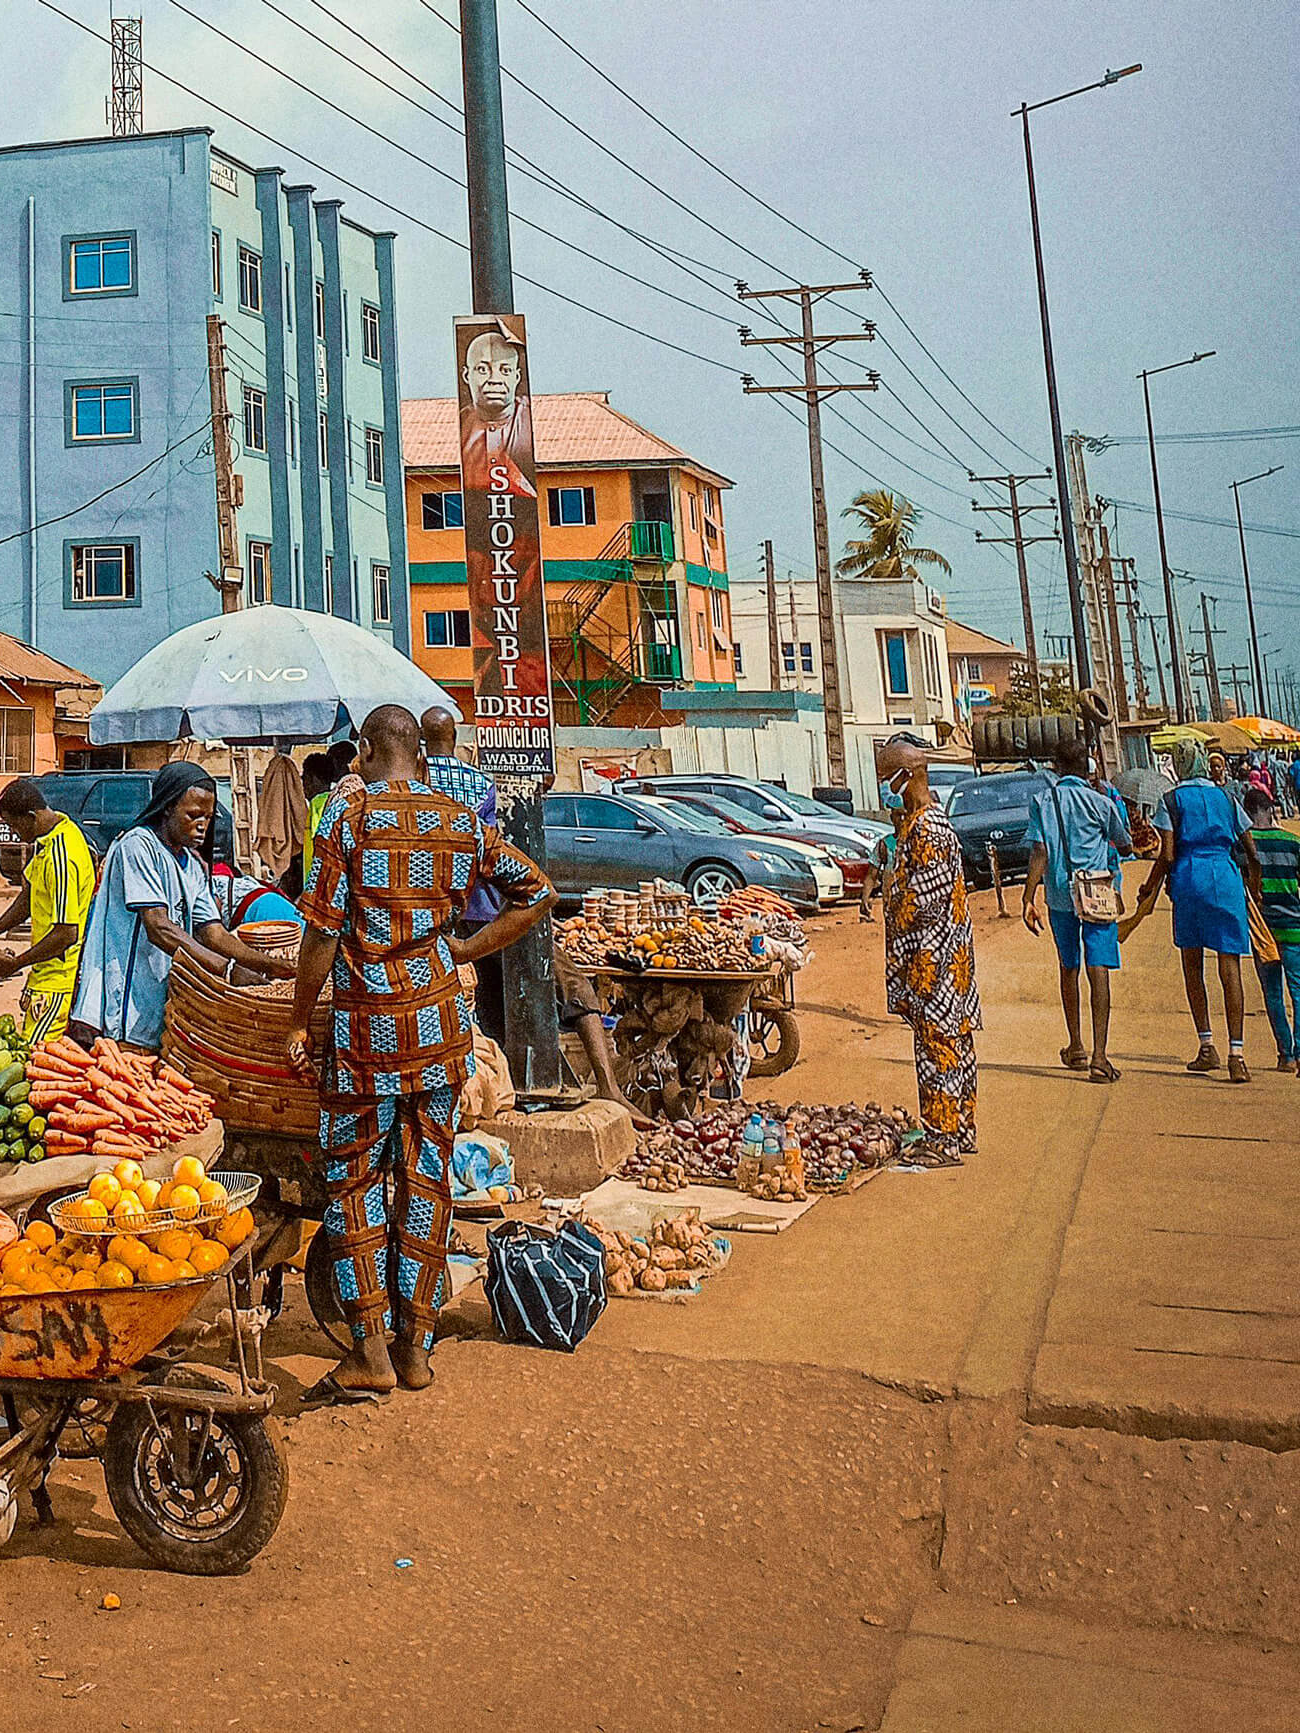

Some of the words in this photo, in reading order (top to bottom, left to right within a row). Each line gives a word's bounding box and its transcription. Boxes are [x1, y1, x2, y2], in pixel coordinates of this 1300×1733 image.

[486, 465, 520, 690] SHOKUNBI
[219, 665, 308, 683] vivo
[474, 695, 550, 717] IDRIS
[477, 727, 550, 749] COUNCILOR
[484, 752, 529, 765] WARD
